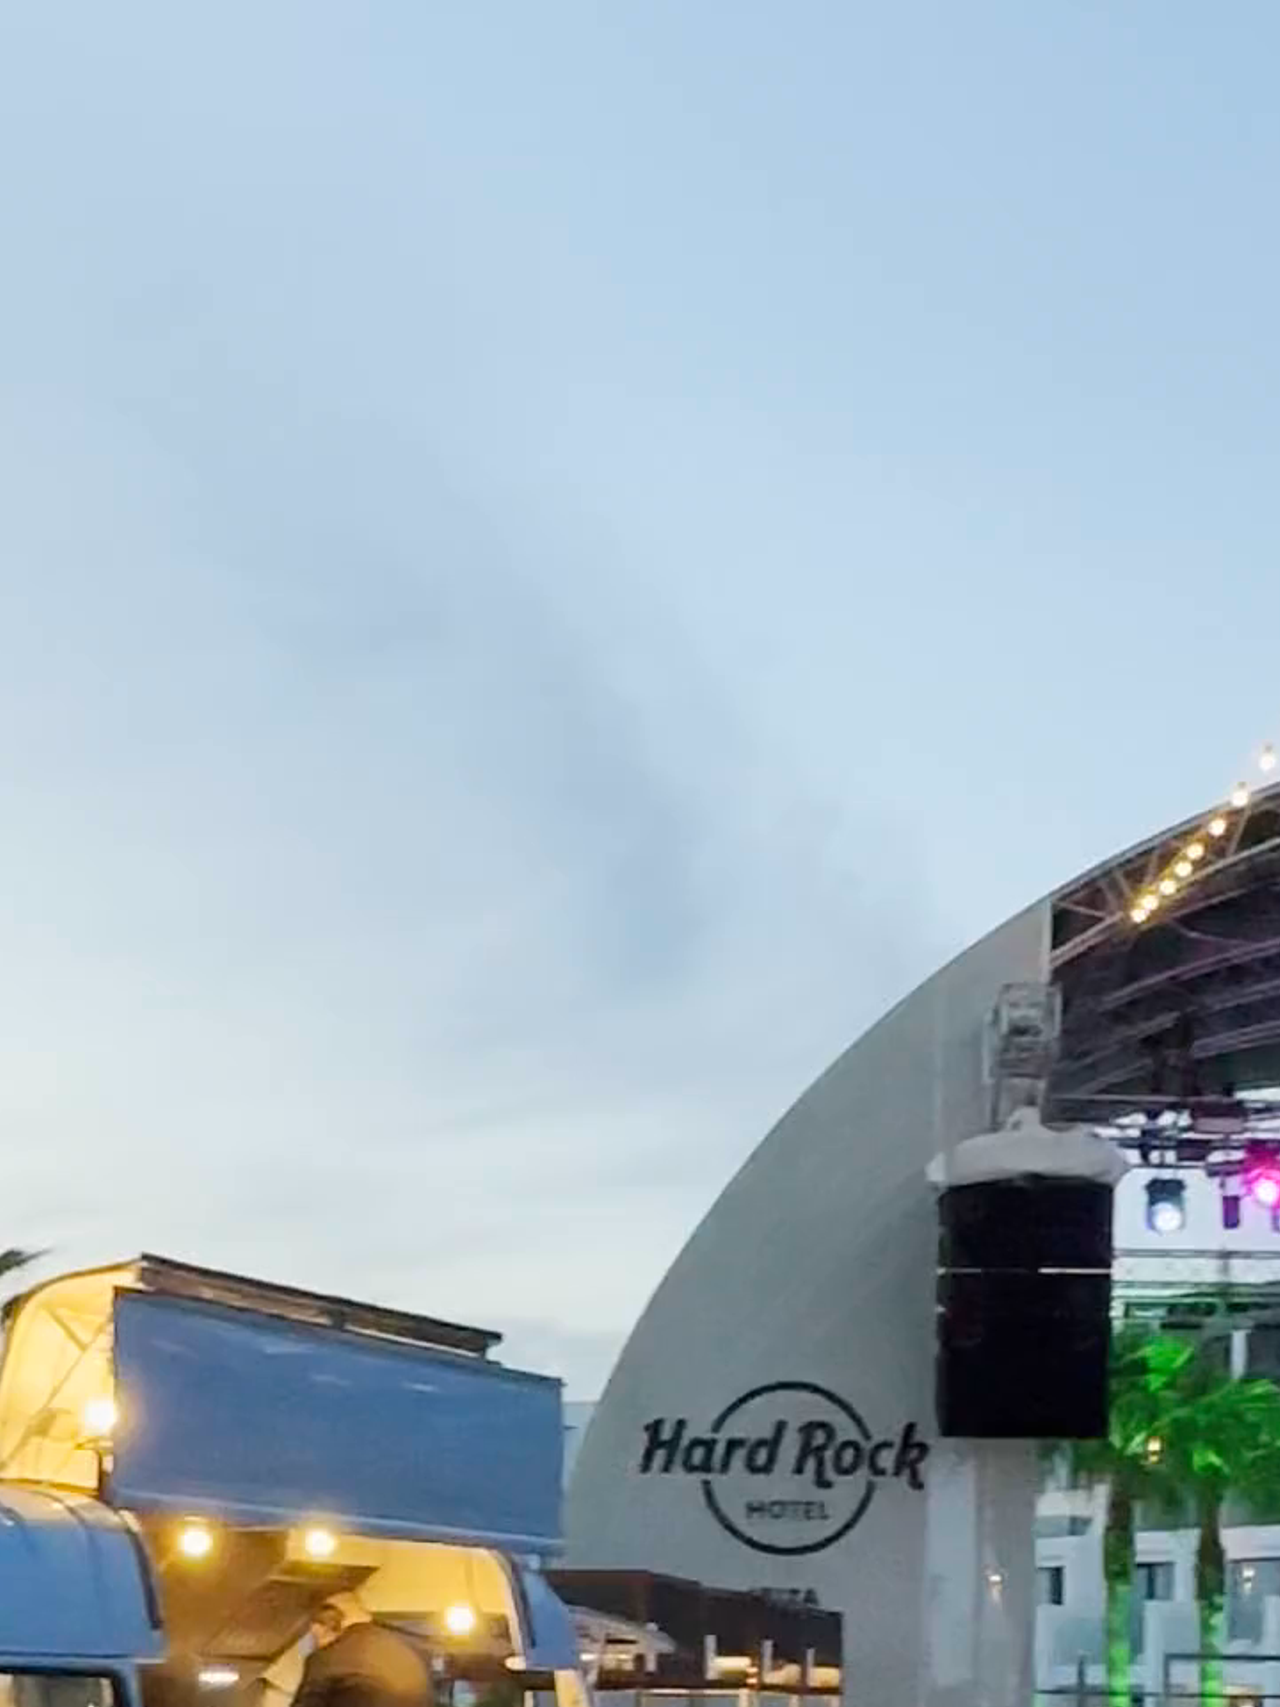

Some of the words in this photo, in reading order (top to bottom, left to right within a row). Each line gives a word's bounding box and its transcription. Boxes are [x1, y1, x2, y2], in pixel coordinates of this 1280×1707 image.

[639, 1417, 788, 1475] Hard
[792, 1420, 930, 1490] Rock
[745, 1499, 831, 1521] HOTEL
